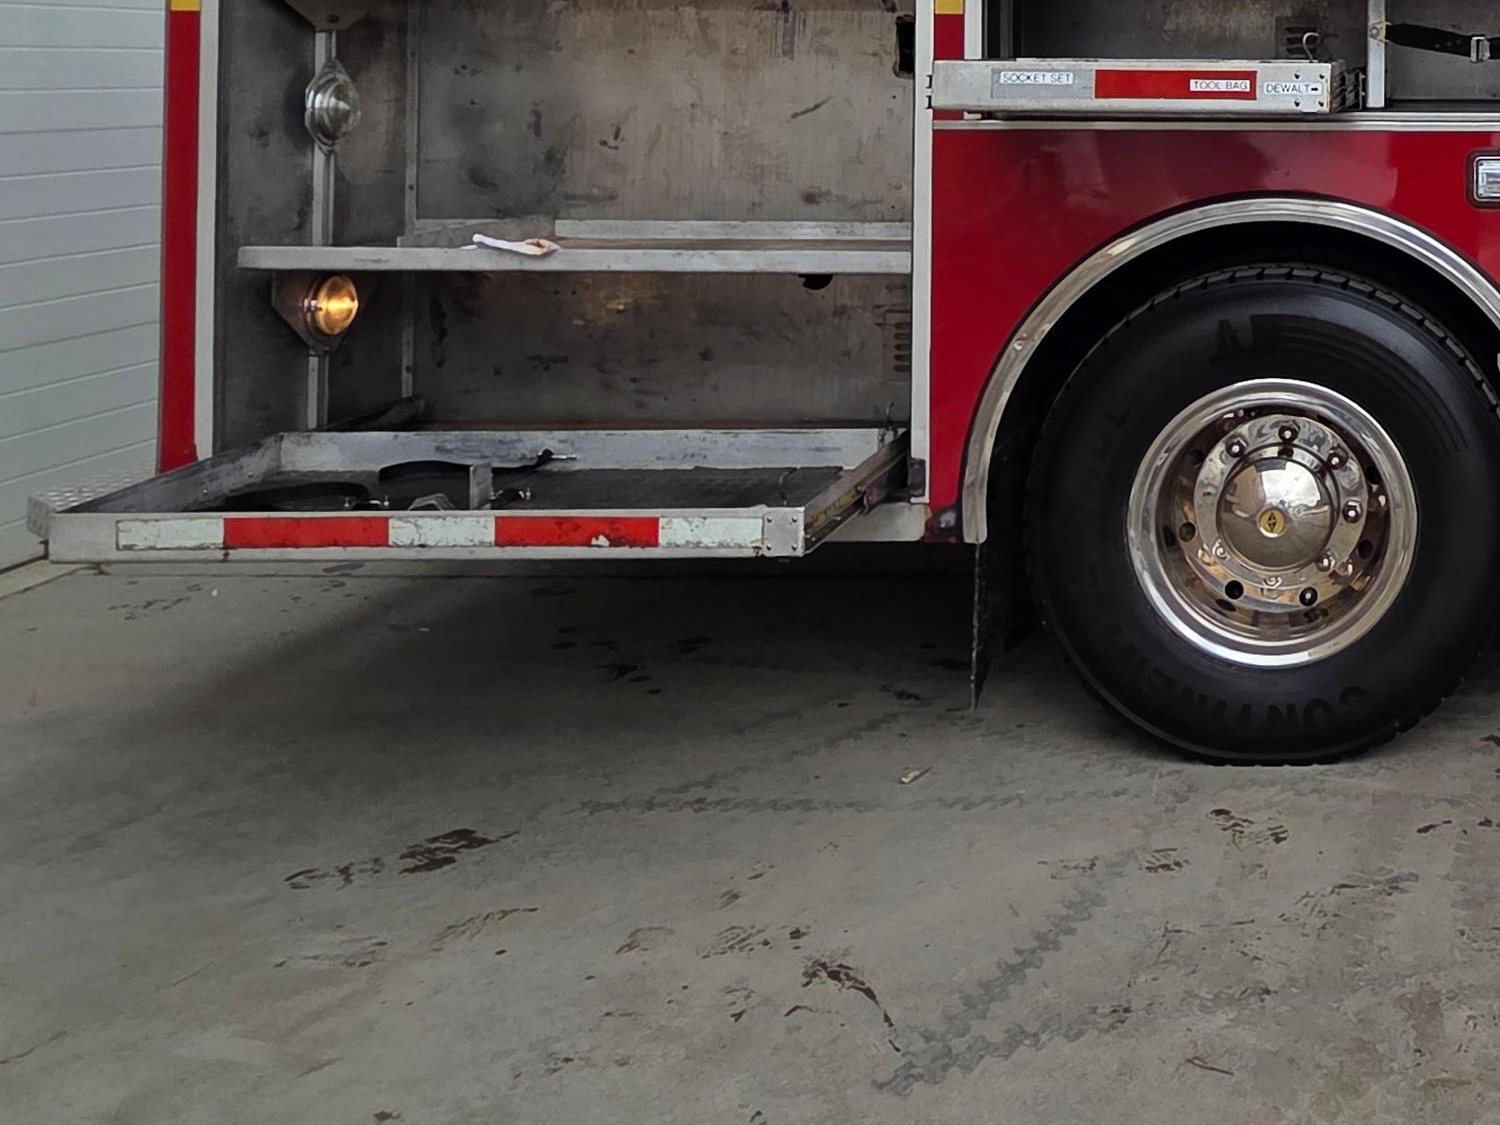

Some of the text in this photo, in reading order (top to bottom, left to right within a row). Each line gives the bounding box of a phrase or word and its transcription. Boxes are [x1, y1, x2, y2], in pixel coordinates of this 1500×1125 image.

[1002, 72, 1072, 84] SOCKET SET
[1193, 80, 1248, 91] TOOL BAG
[1265, 83, 1310, 94] DEWALT
